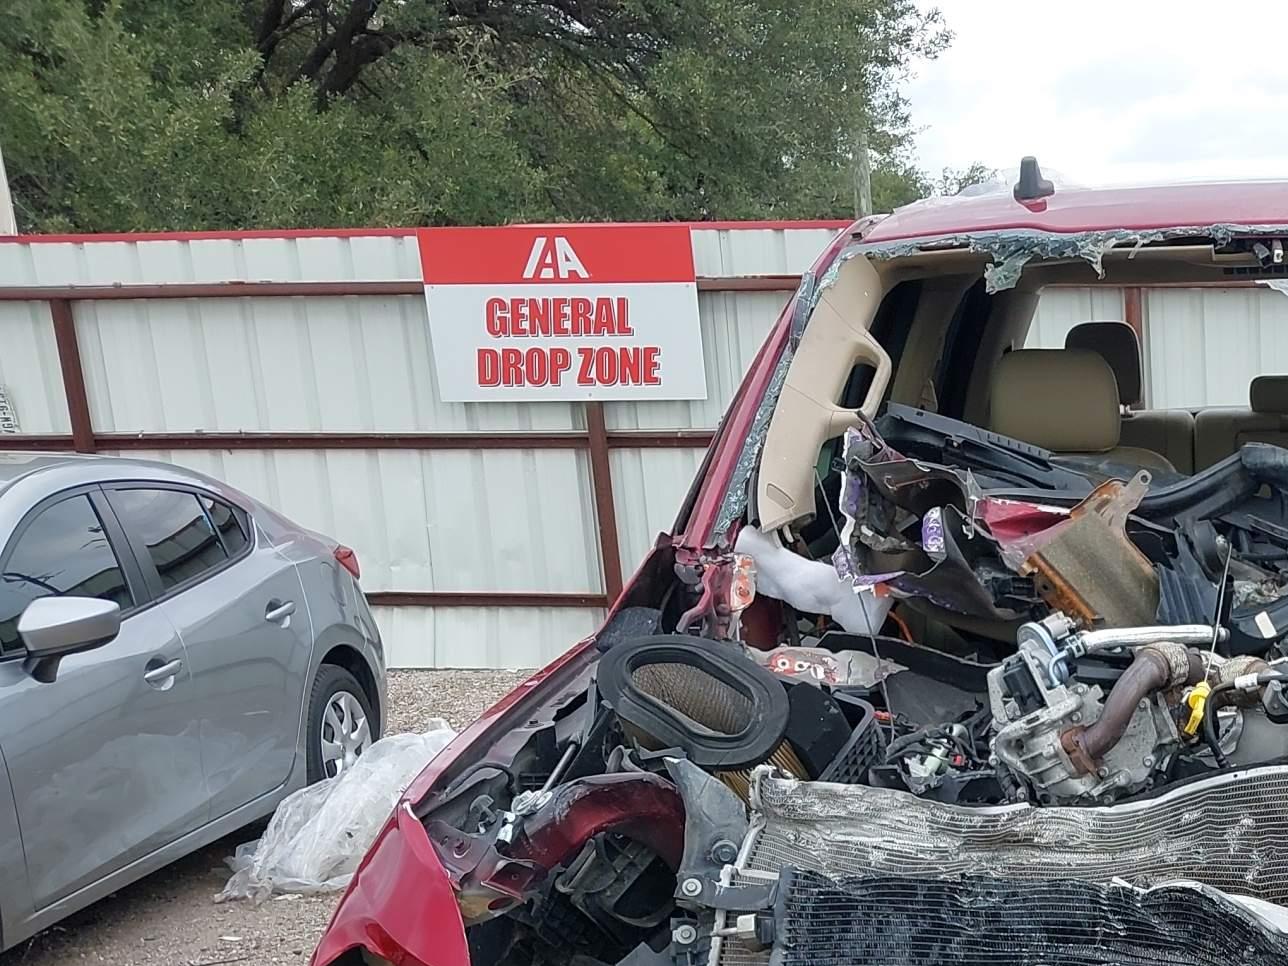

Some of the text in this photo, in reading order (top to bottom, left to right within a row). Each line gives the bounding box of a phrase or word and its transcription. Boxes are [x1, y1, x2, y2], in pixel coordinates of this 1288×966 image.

[485, 297, 634, 338] GENERAL
[476, 346, 662, 388] DROP ZONE
